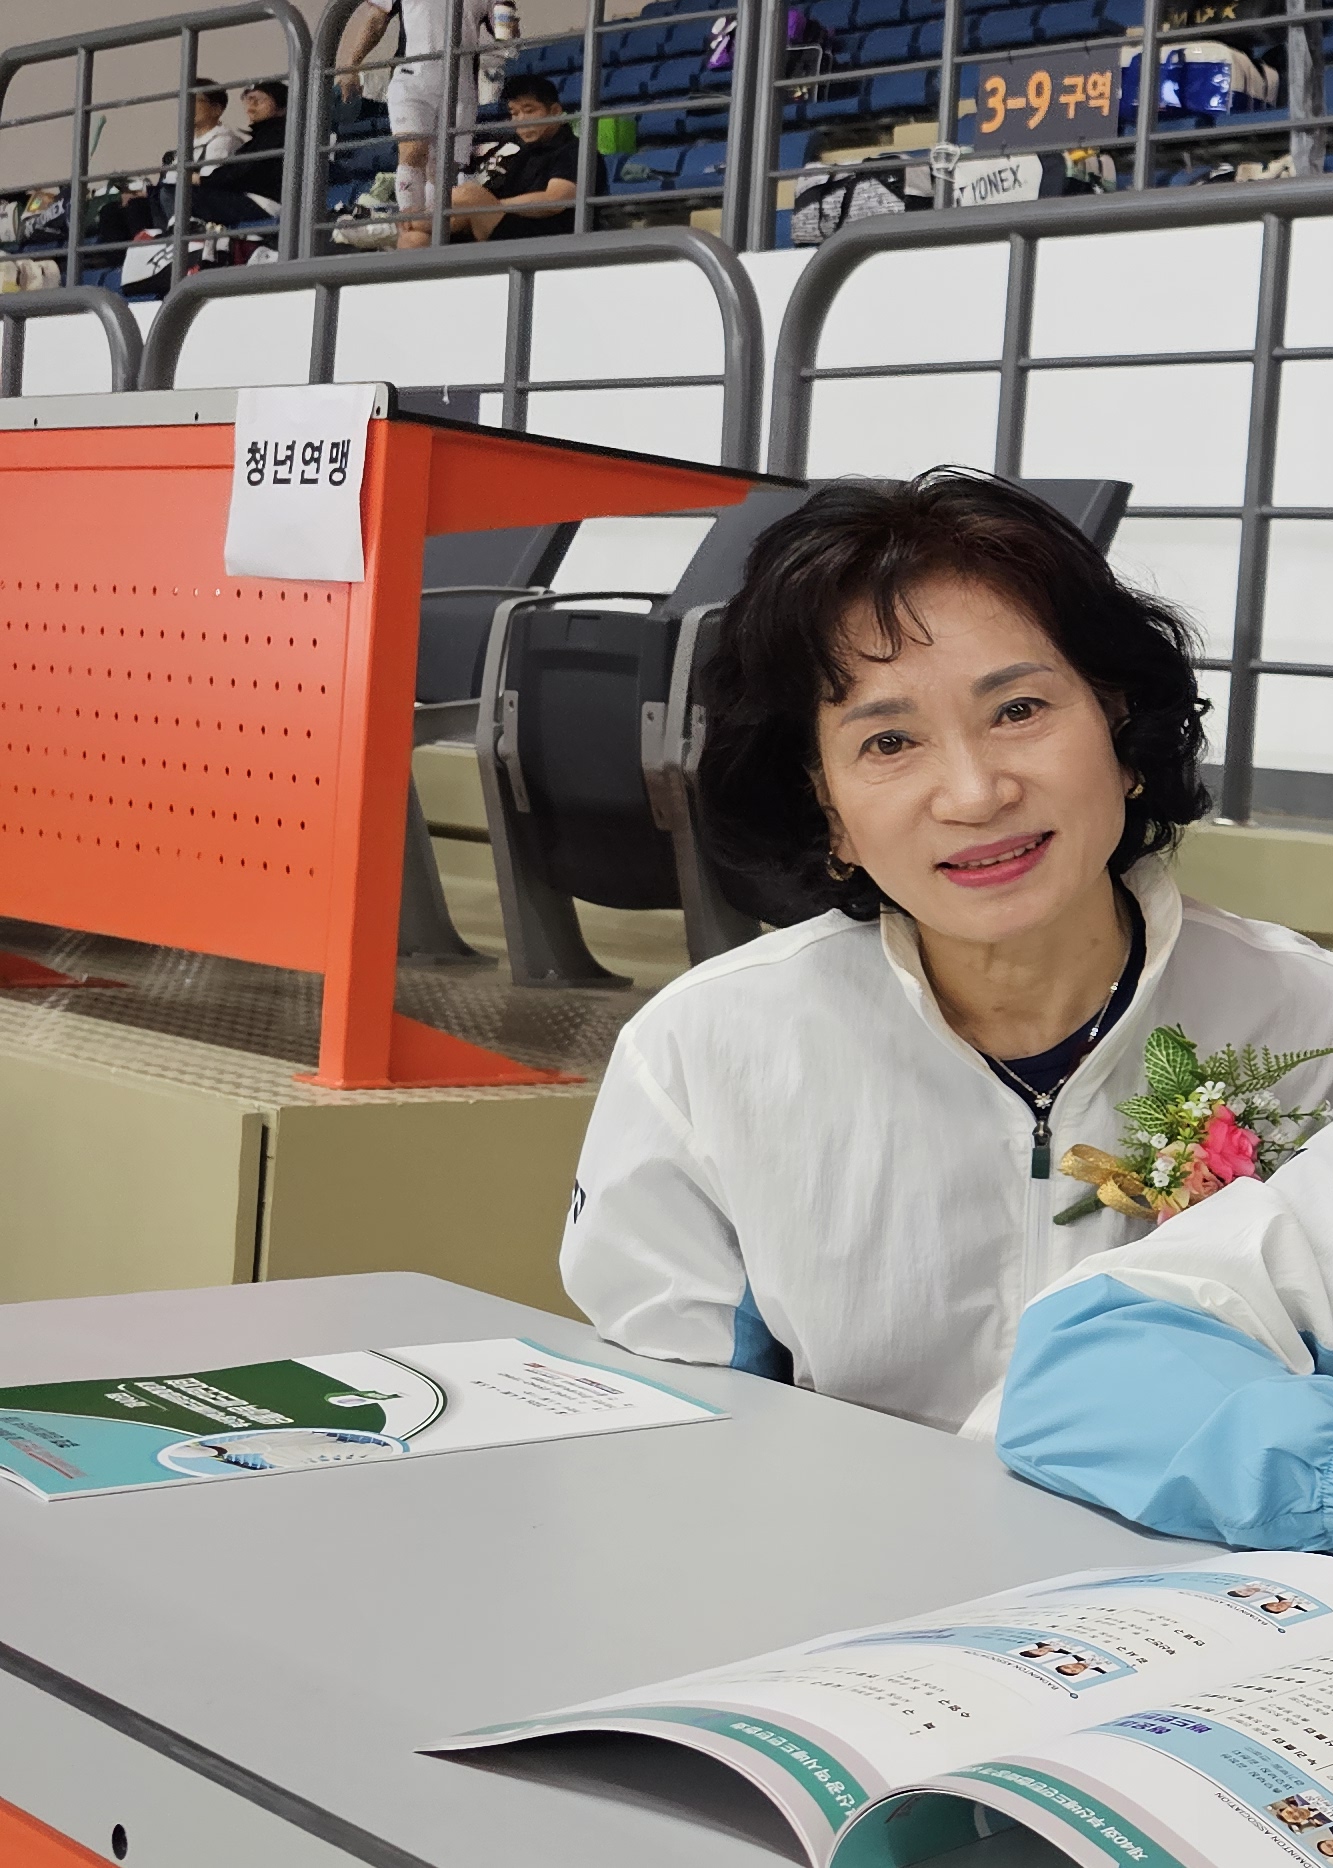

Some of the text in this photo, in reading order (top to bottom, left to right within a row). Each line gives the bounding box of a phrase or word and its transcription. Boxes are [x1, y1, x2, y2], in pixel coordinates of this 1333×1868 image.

[980, 70, 1112, 133] 3-9 구역
[971, 164, 1022, 203] YONEX
[246, 439, 351, 486] 청년연맹
[1214, 1791, 1270, 1837] ASSOCIATION
[1101, 1825, 1149, 1862] 제40회
